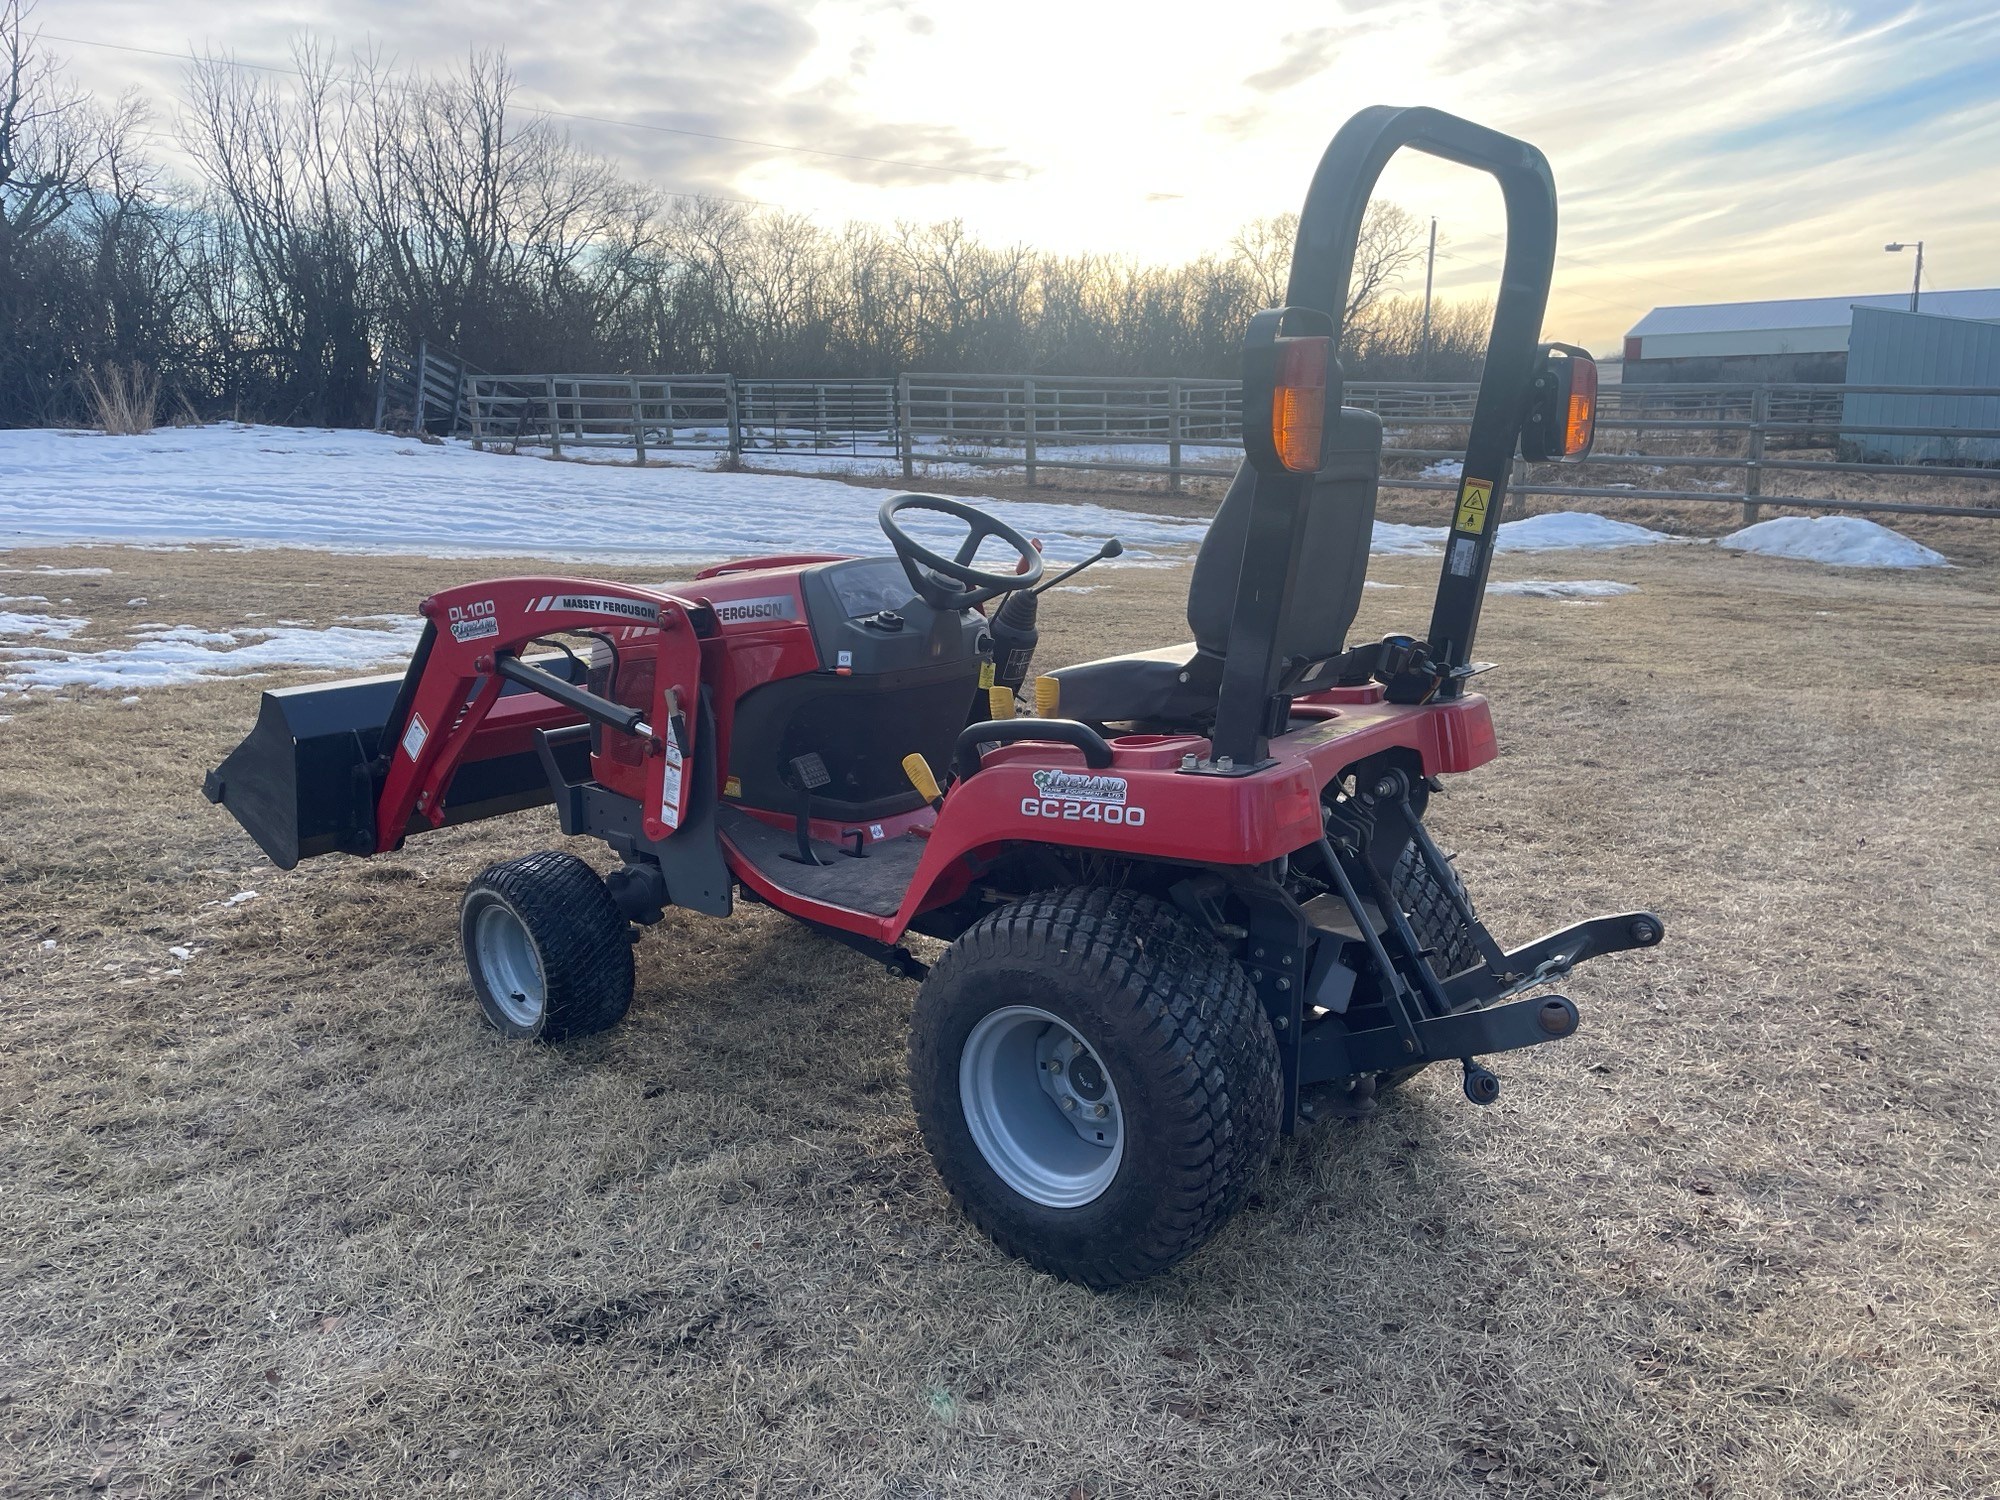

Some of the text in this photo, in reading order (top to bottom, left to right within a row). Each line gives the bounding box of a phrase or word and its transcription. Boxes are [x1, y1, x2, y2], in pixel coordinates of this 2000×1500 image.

[448, 600, 496, 621] DL100
[563, 599, 656, 618] MASSEY FERGUSON
[1021, 798, 1145, 826] GC2400
